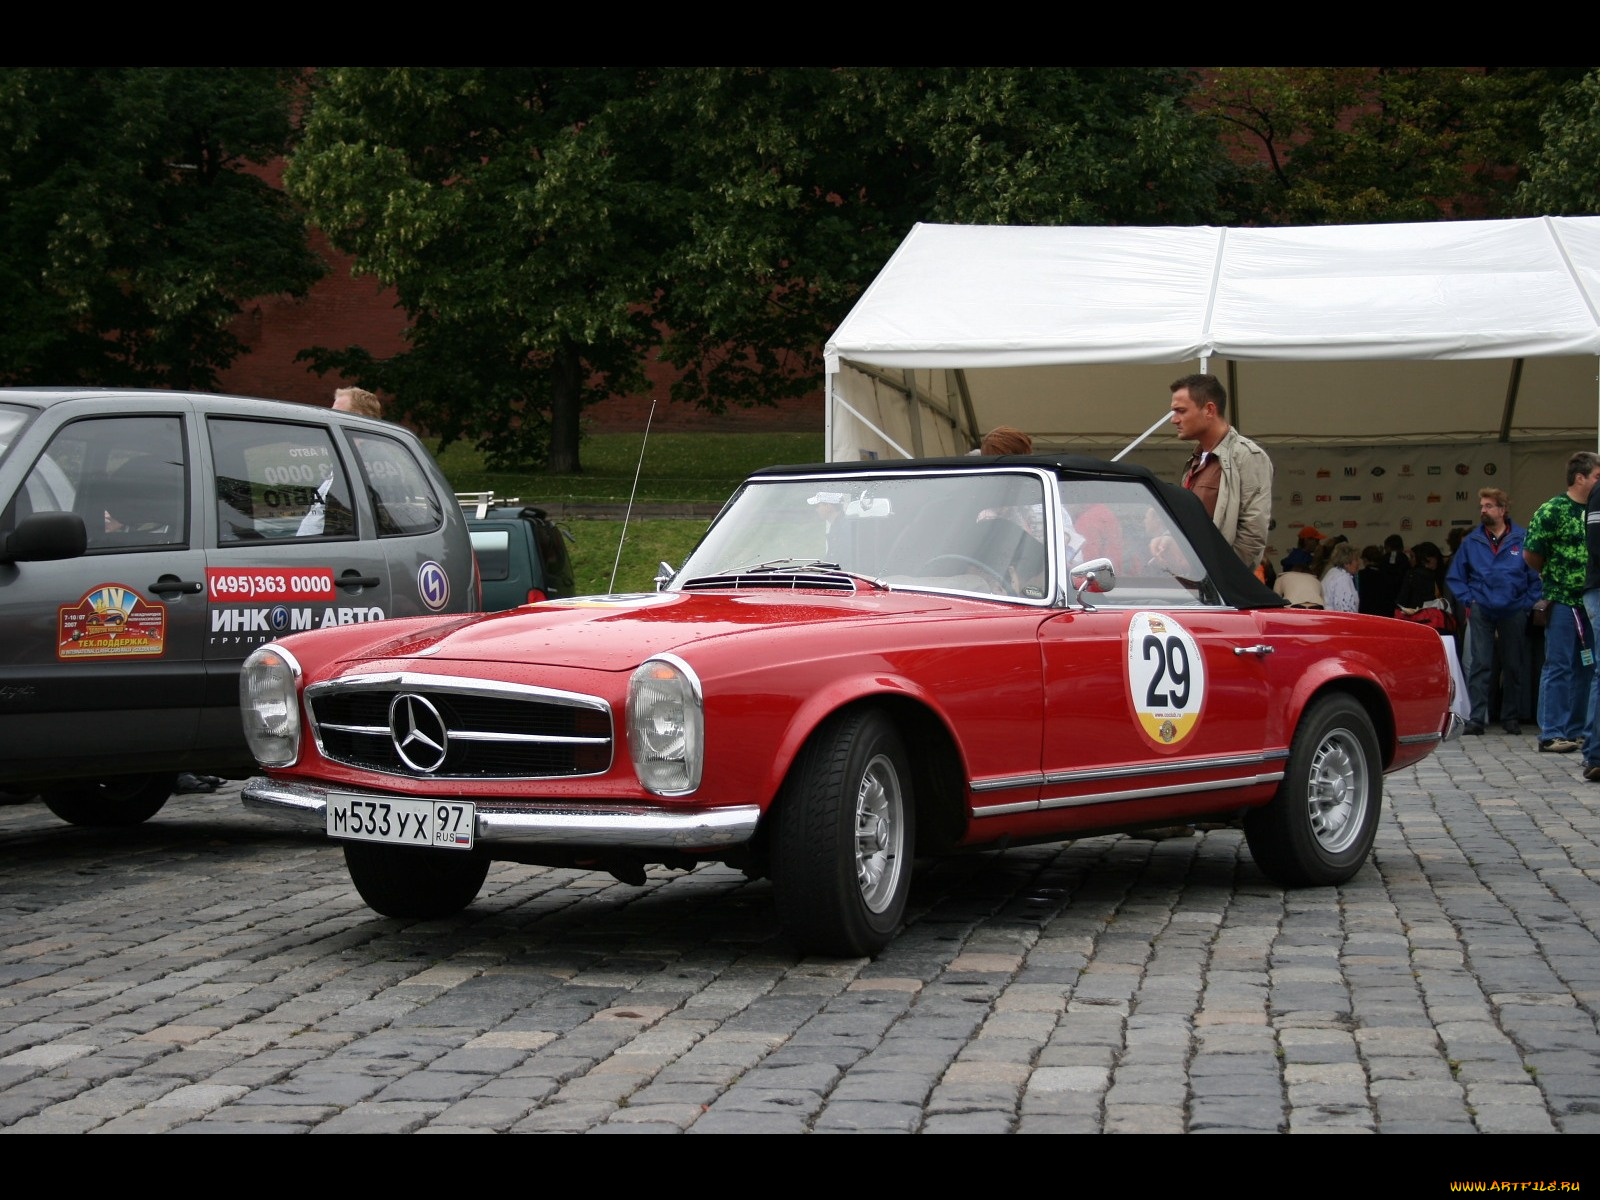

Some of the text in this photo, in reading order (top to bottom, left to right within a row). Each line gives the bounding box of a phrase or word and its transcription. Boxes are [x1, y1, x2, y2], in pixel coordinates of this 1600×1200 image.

[210, 575, 331, 598] (495)363 0000
[1142, 634, 1191, 710] 29
[437, 805, 464, 832] 97
[435, 831, 455, 842] RUS
